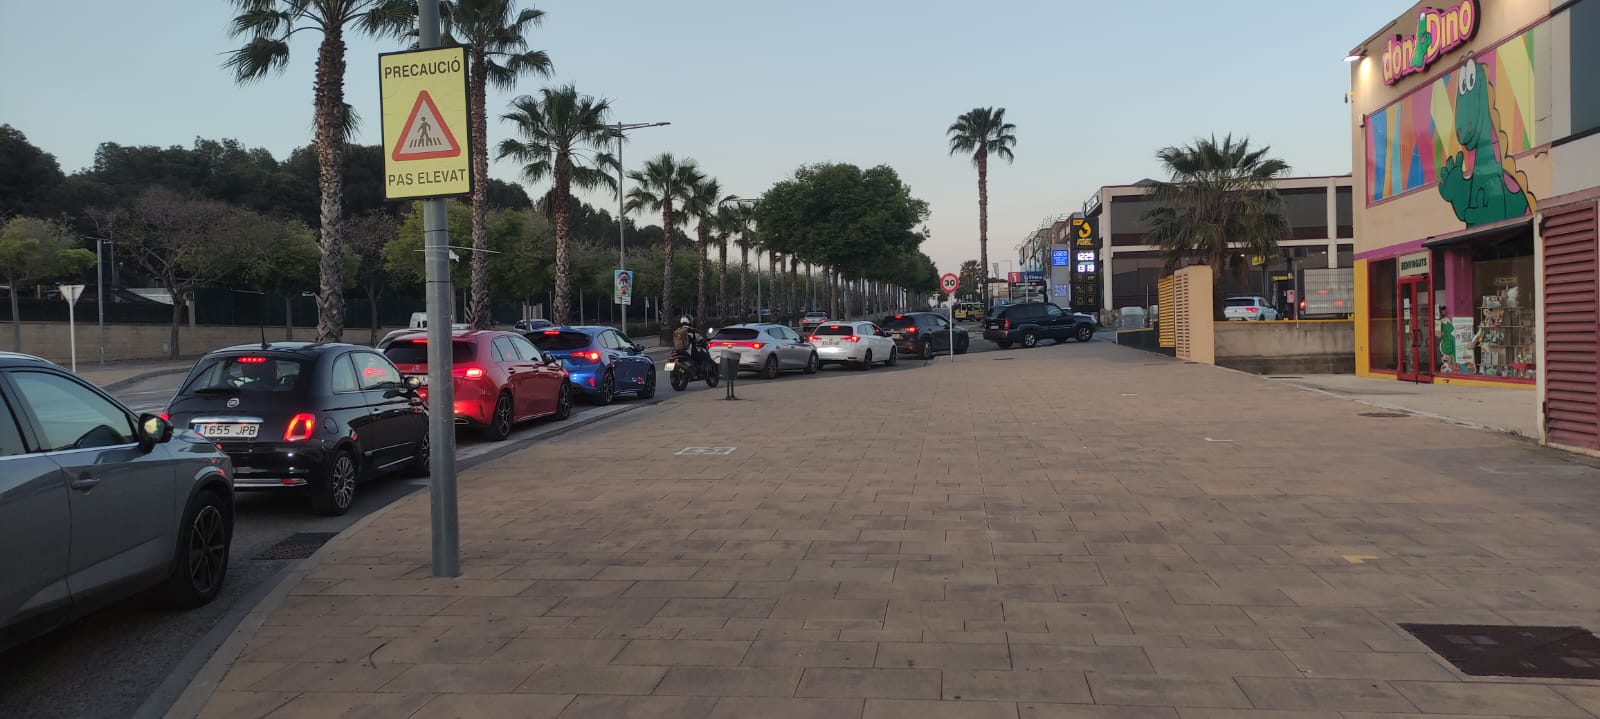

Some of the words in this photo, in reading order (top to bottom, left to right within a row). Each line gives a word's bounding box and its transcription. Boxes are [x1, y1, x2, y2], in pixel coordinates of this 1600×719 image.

[1382, 39, 1414, 82] don
[1425, 0, 1472, 58] Dino
[384, 56, 461, 80] PRECAUCIÓ
[388, 173, 414, 187] PAS
[417, 168, 466, 185] ELEVAT
[944, 279, 956, 287] 30
[203, 425, 231, 435] 1655
[235, 425, 257, 436] JPB
